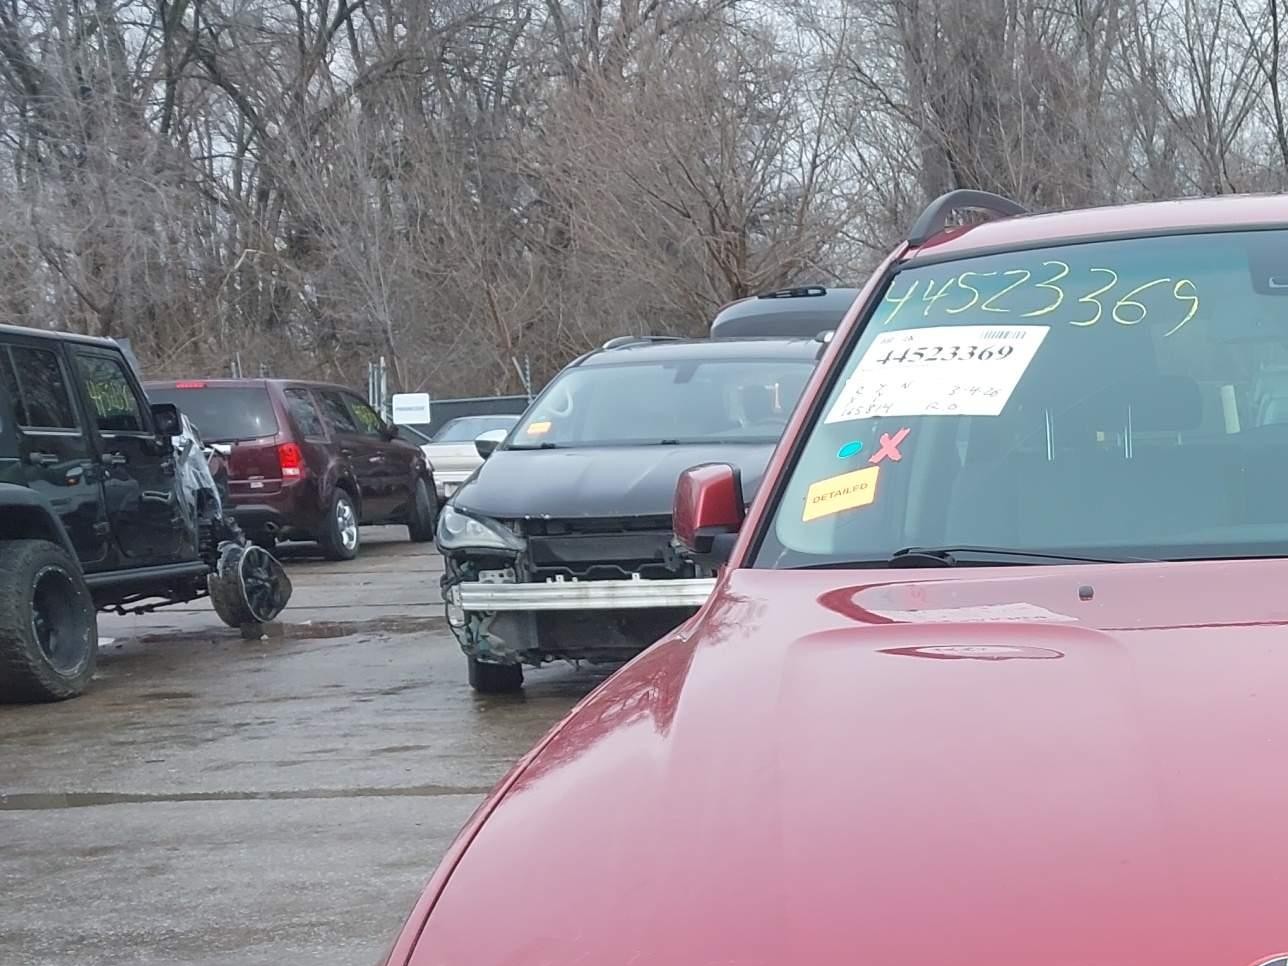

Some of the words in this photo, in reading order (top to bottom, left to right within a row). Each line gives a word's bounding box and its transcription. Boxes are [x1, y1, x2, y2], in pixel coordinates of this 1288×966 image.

[881, 260, 1199, 338] 44523369
[876, 344, 1015, 366] 44523369
[811, 482, 869, 505] DETAILED
